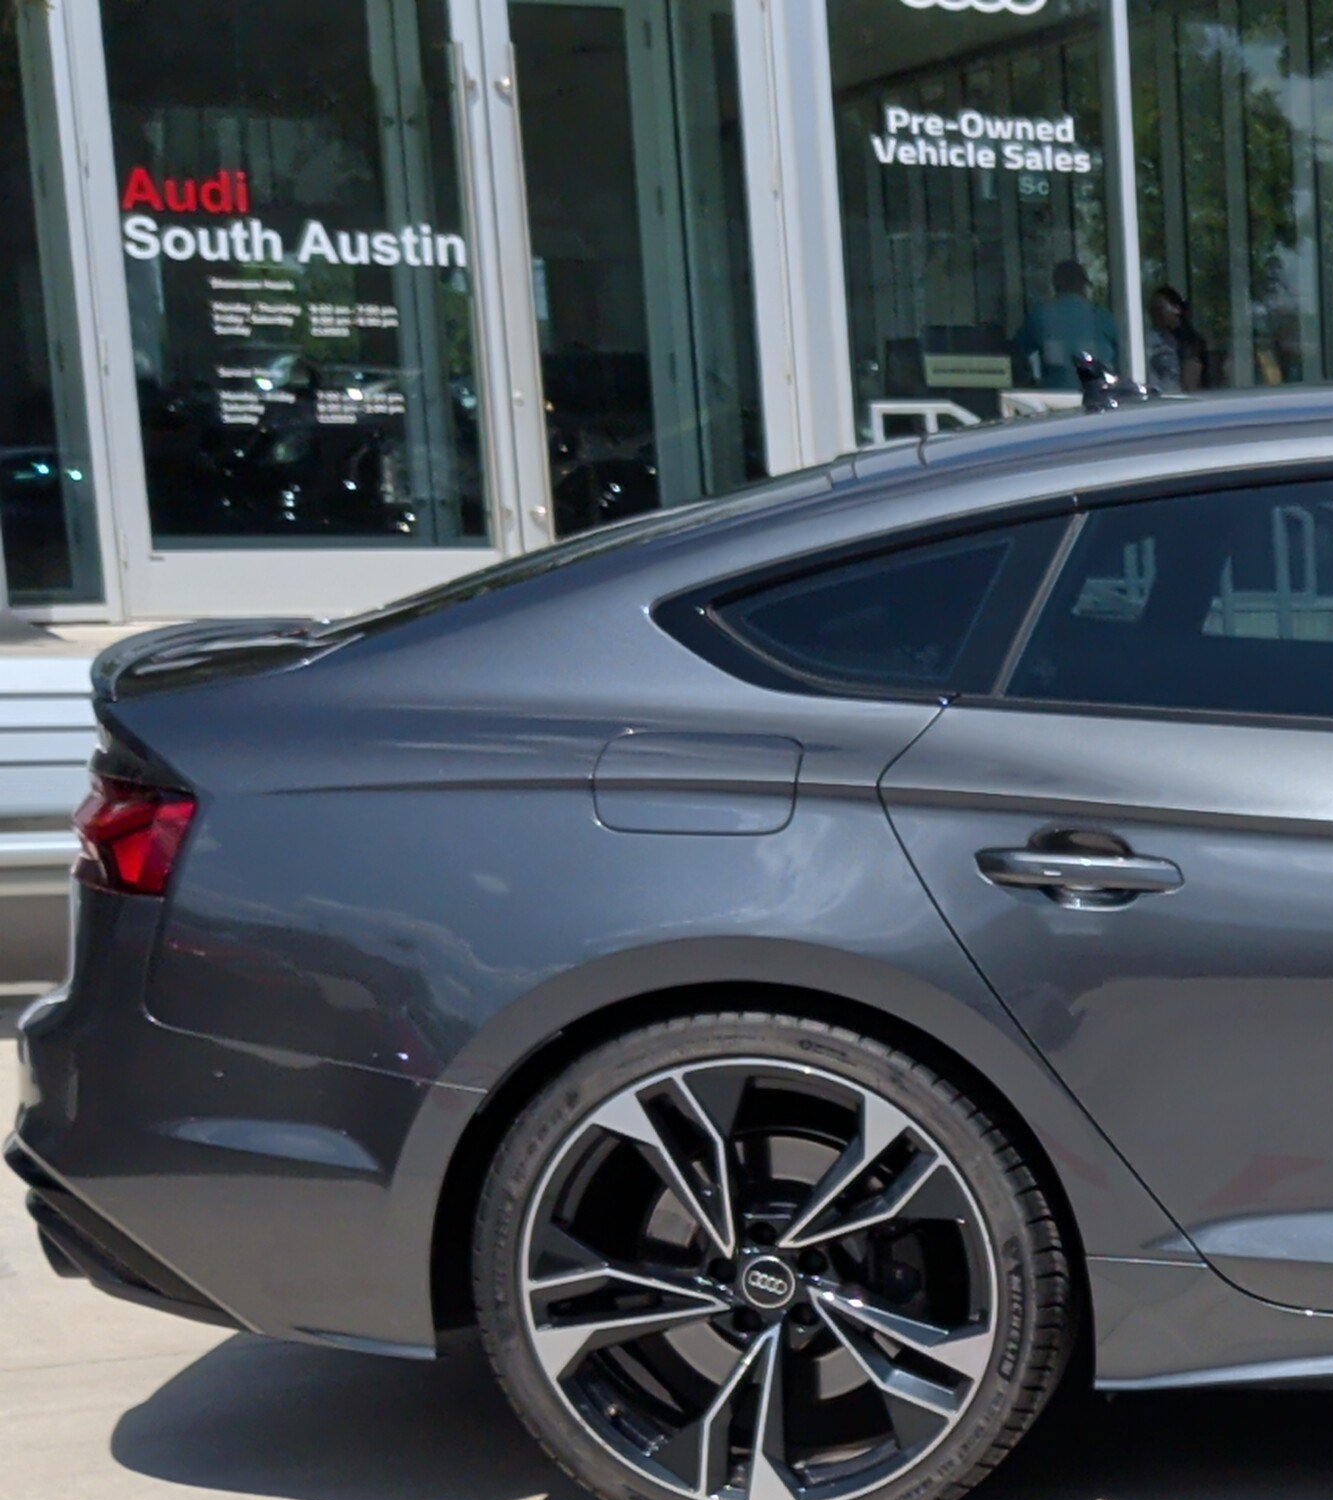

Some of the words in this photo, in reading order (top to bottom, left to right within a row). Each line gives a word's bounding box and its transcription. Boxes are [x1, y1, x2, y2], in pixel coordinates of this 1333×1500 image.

[885, 105, 1075, 143] Pre-Owned
[871, 134, 996, 169] Vehicle
[1003, 142, 1091, 174] Sales
[122, 167, 248, 215] Audi
[123, 214, 284, 262] South
[298, 219, 467, 268] Austin
